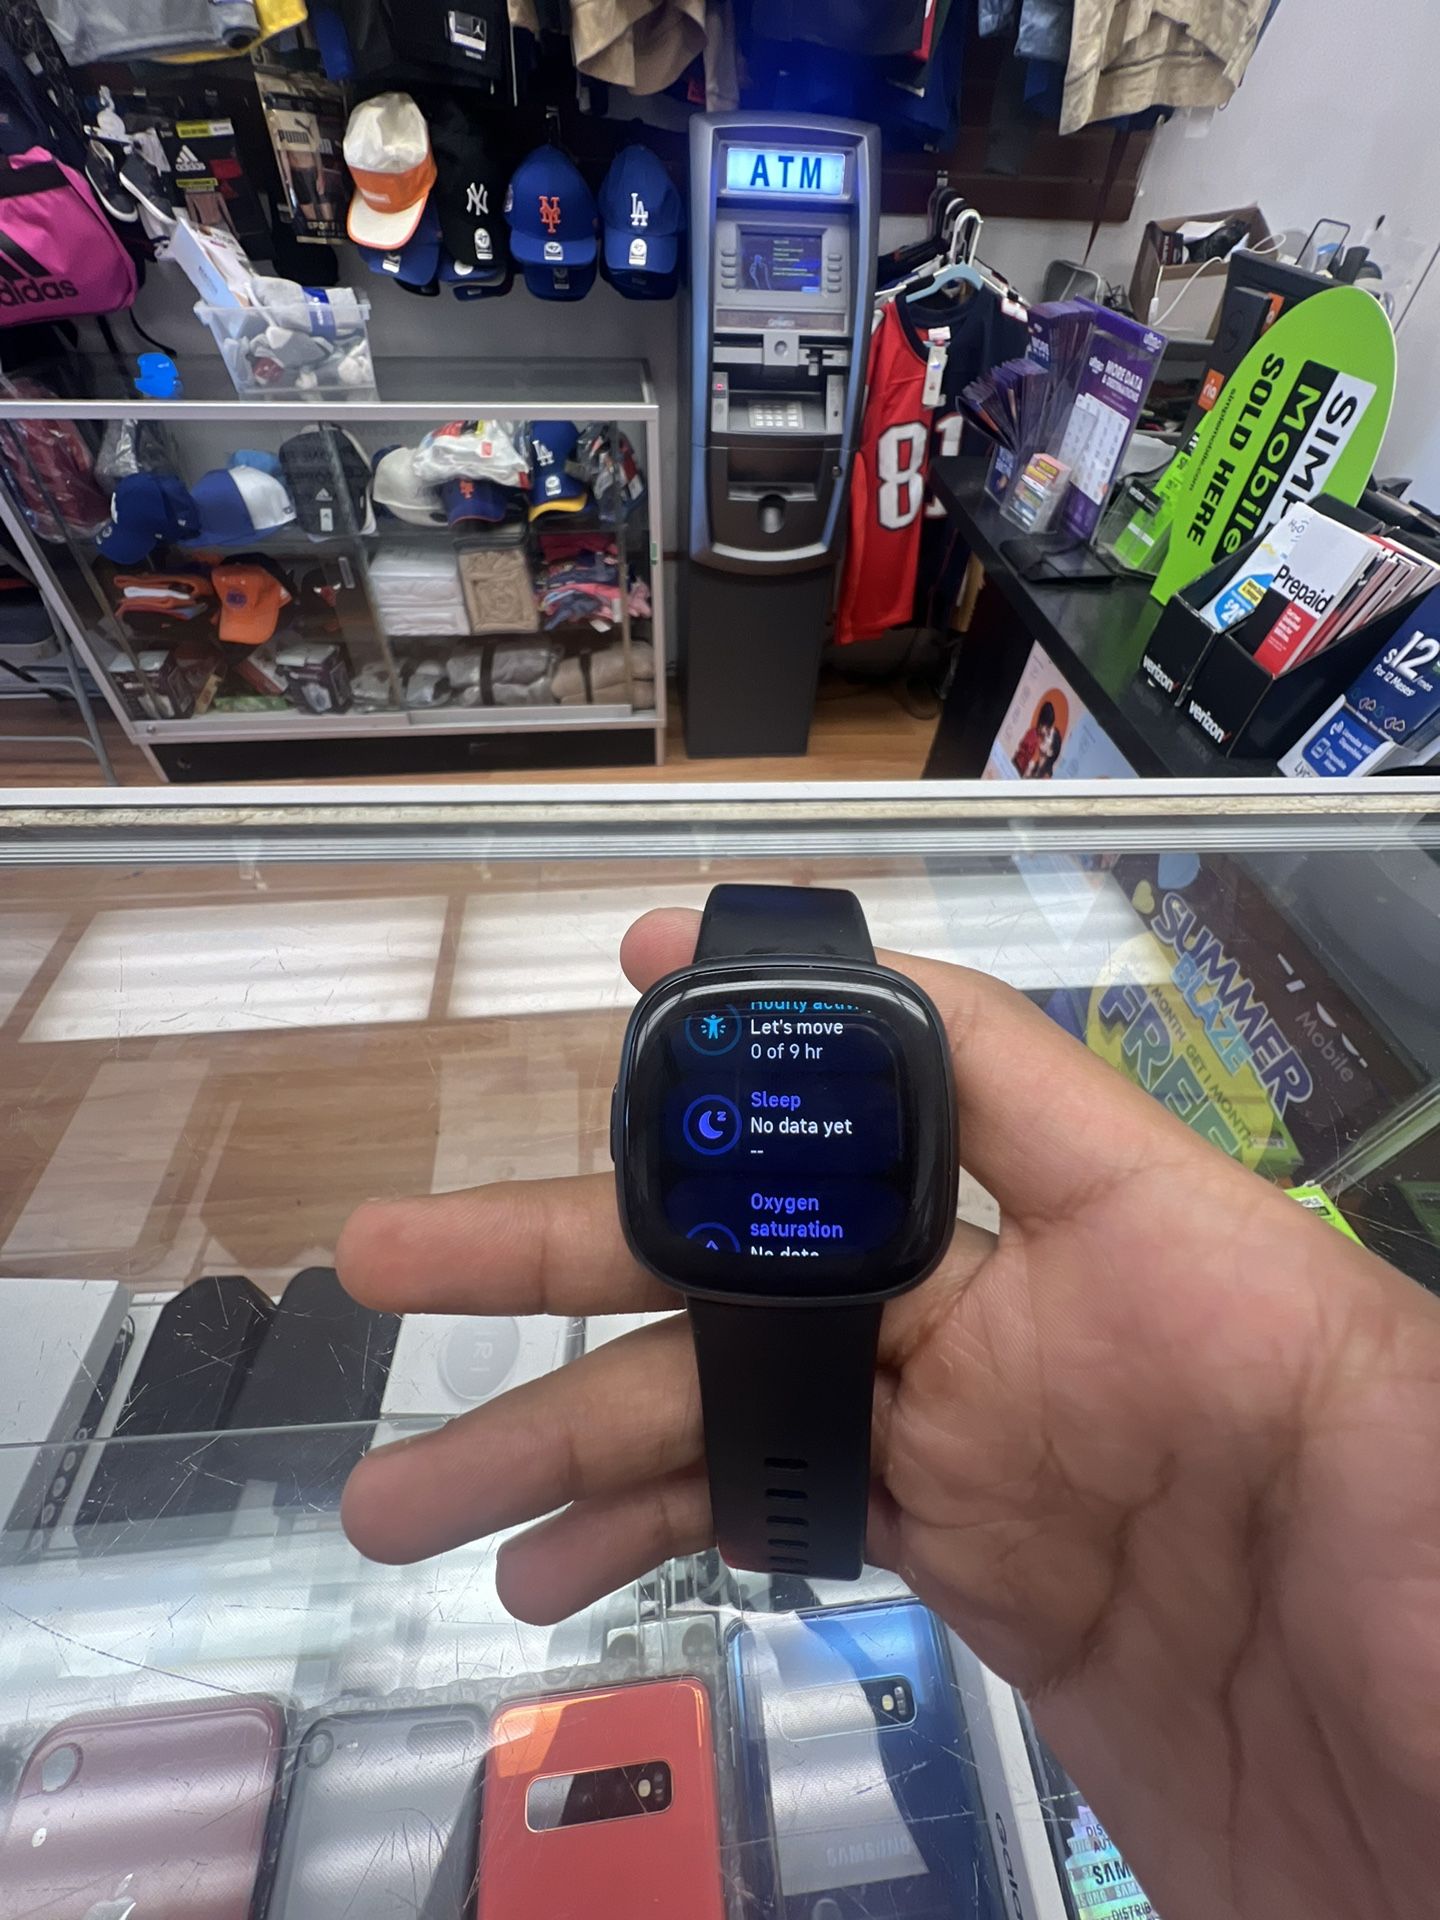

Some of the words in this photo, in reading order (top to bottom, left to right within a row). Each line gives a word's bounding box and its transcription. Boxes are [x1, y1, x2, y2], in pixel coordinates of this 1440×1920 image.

[750, 154, 822, 190] ATM
[631, 193, 648, 226] LA
[1229, 352, 1285, 452] SOLD
[879, 421, 928, 530] 8
[1223, 384, 1322, 555] Mobile
[1272, 391, 1358, 528] SIMP
[1187, 458, 1236, 546] HERE
[1273, 564, 1335, 614] Prepaid
[1142, 654, 1174, 693] verizon
[1188, 700, 1225, 744] verizon
[750, 1018, 793, 1035] Let's
[796, 1022, 844, 1035] move
[1150, 892, 1314, 1120] SUMMER
[1171, 953, 1253, 1077] BLAZE
[750, 1043, 762, 1060] 0
[766, 1042, 785, 1060] of
[789, 1043, 800, 1060] 9
[804, 1042, 824, 1060] hr
[1295, 1009, 1355, 1083] Mobile
[750, 1090, 802, 1112] Sleep
[750, 1116, 774, 1134] No
[778, 1116, 819, 1135] data
[822, 1118, 853, 1138] yet
[750, 1192, 820, 1215] Oxygen
[750, 1219, 844, 1239] saturation
[1092, 1860, 1132, 1886] SAM
